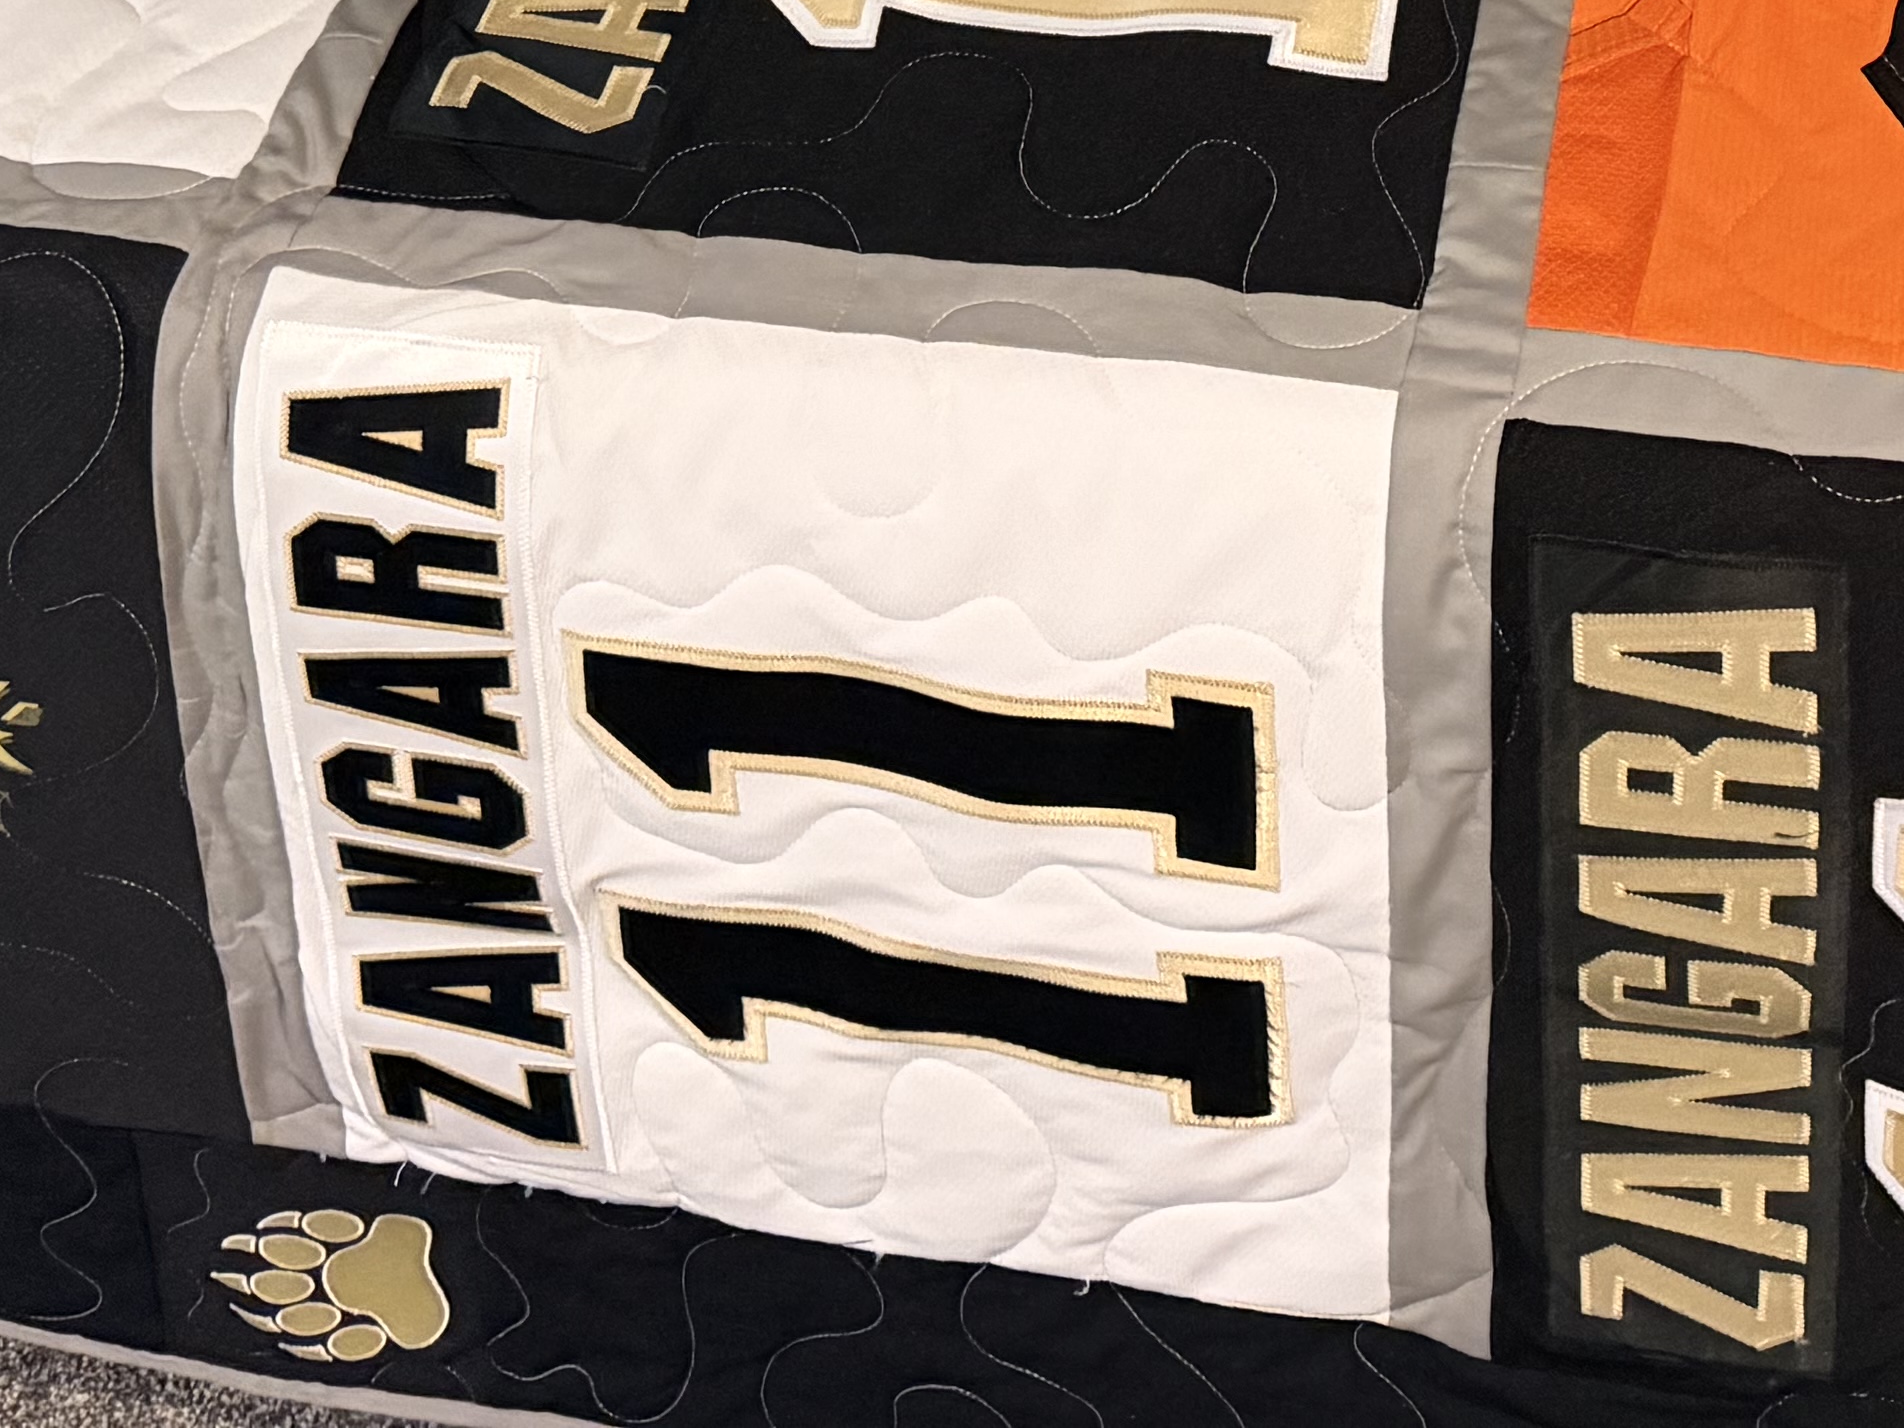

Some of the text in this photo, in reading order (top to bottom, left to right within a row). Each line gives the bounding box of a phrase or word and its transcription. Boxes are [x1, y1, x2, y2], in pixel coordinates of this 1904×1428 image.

[281, 377, 592, 1149] ZANGARA
[560, 628, 1297, 1130] 11
[1571, 606, 1820, 1352] ZANGARA
